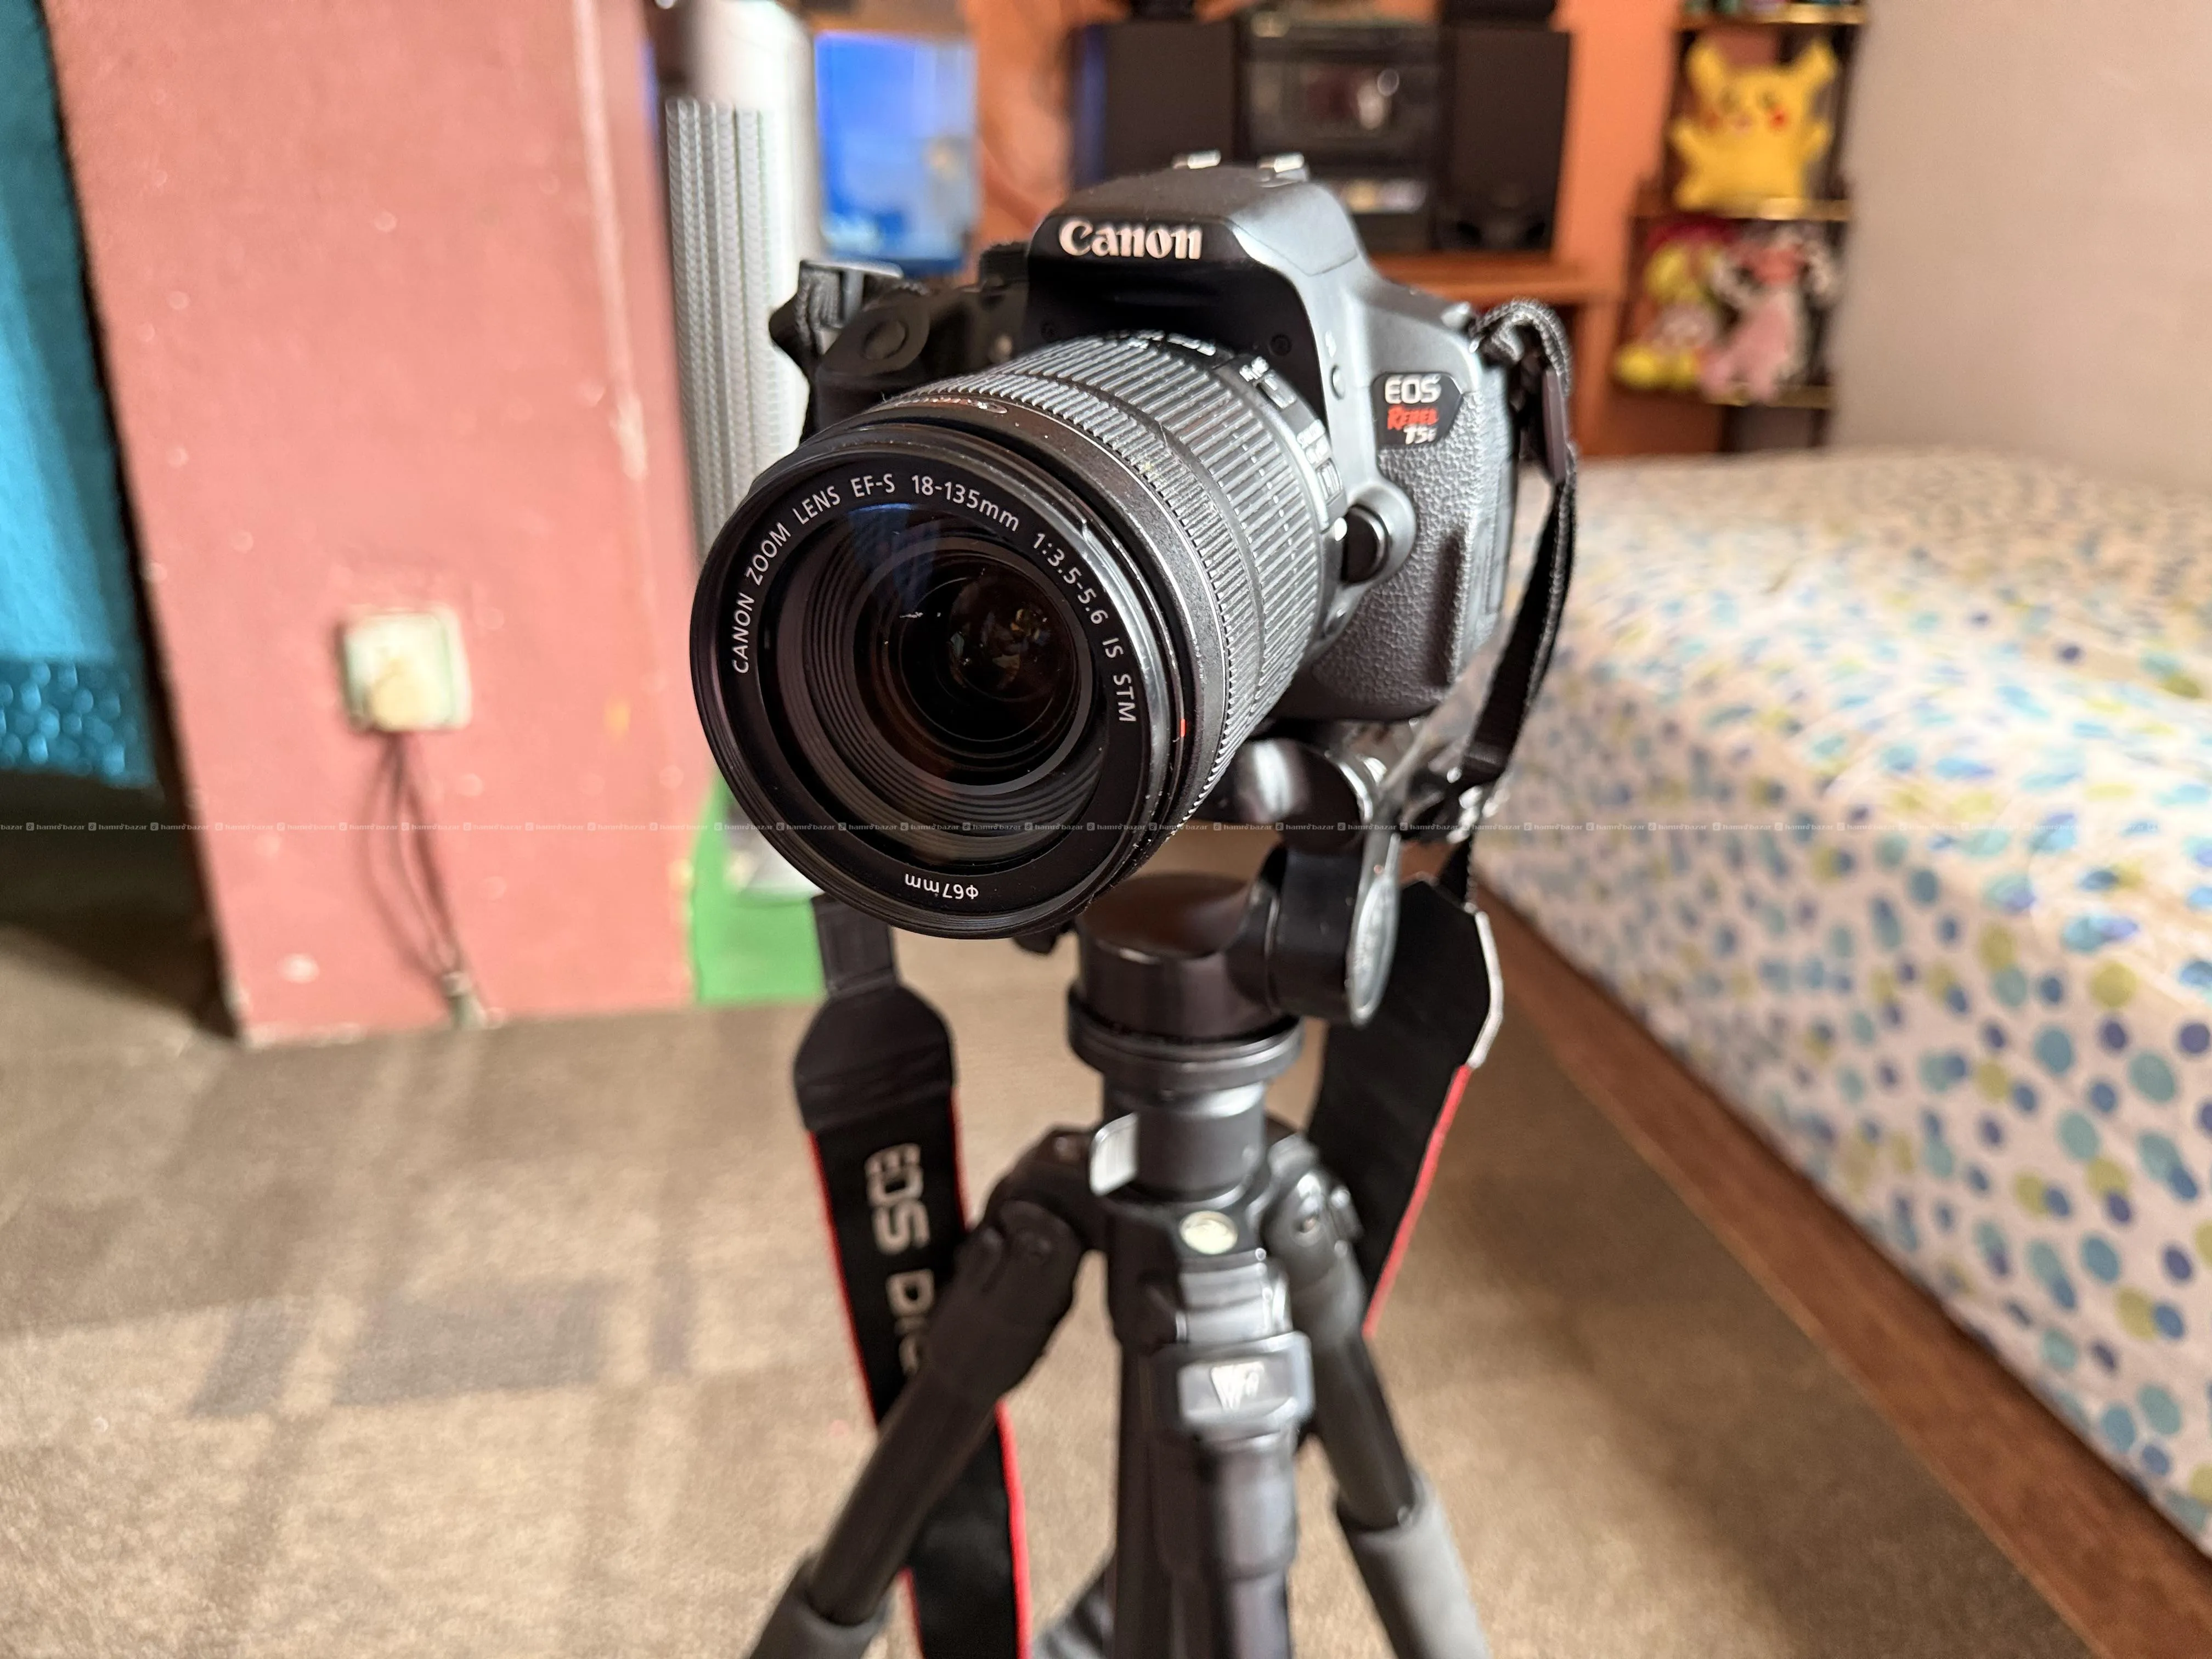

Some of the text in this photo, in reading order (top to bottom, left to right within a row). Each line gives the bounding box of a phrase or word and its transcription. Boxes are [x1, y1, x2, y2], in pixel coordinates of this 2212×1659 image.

[1058, 219, 1203, 259] Canon
[1385, 374, 1442, 404] EOS
[732, 473, 1137, 723] CANON ZOOM LENS EF-S 18-135mm 1:3.5-5.6 IS STM
[864, 1142, 931, 1255] EOS
